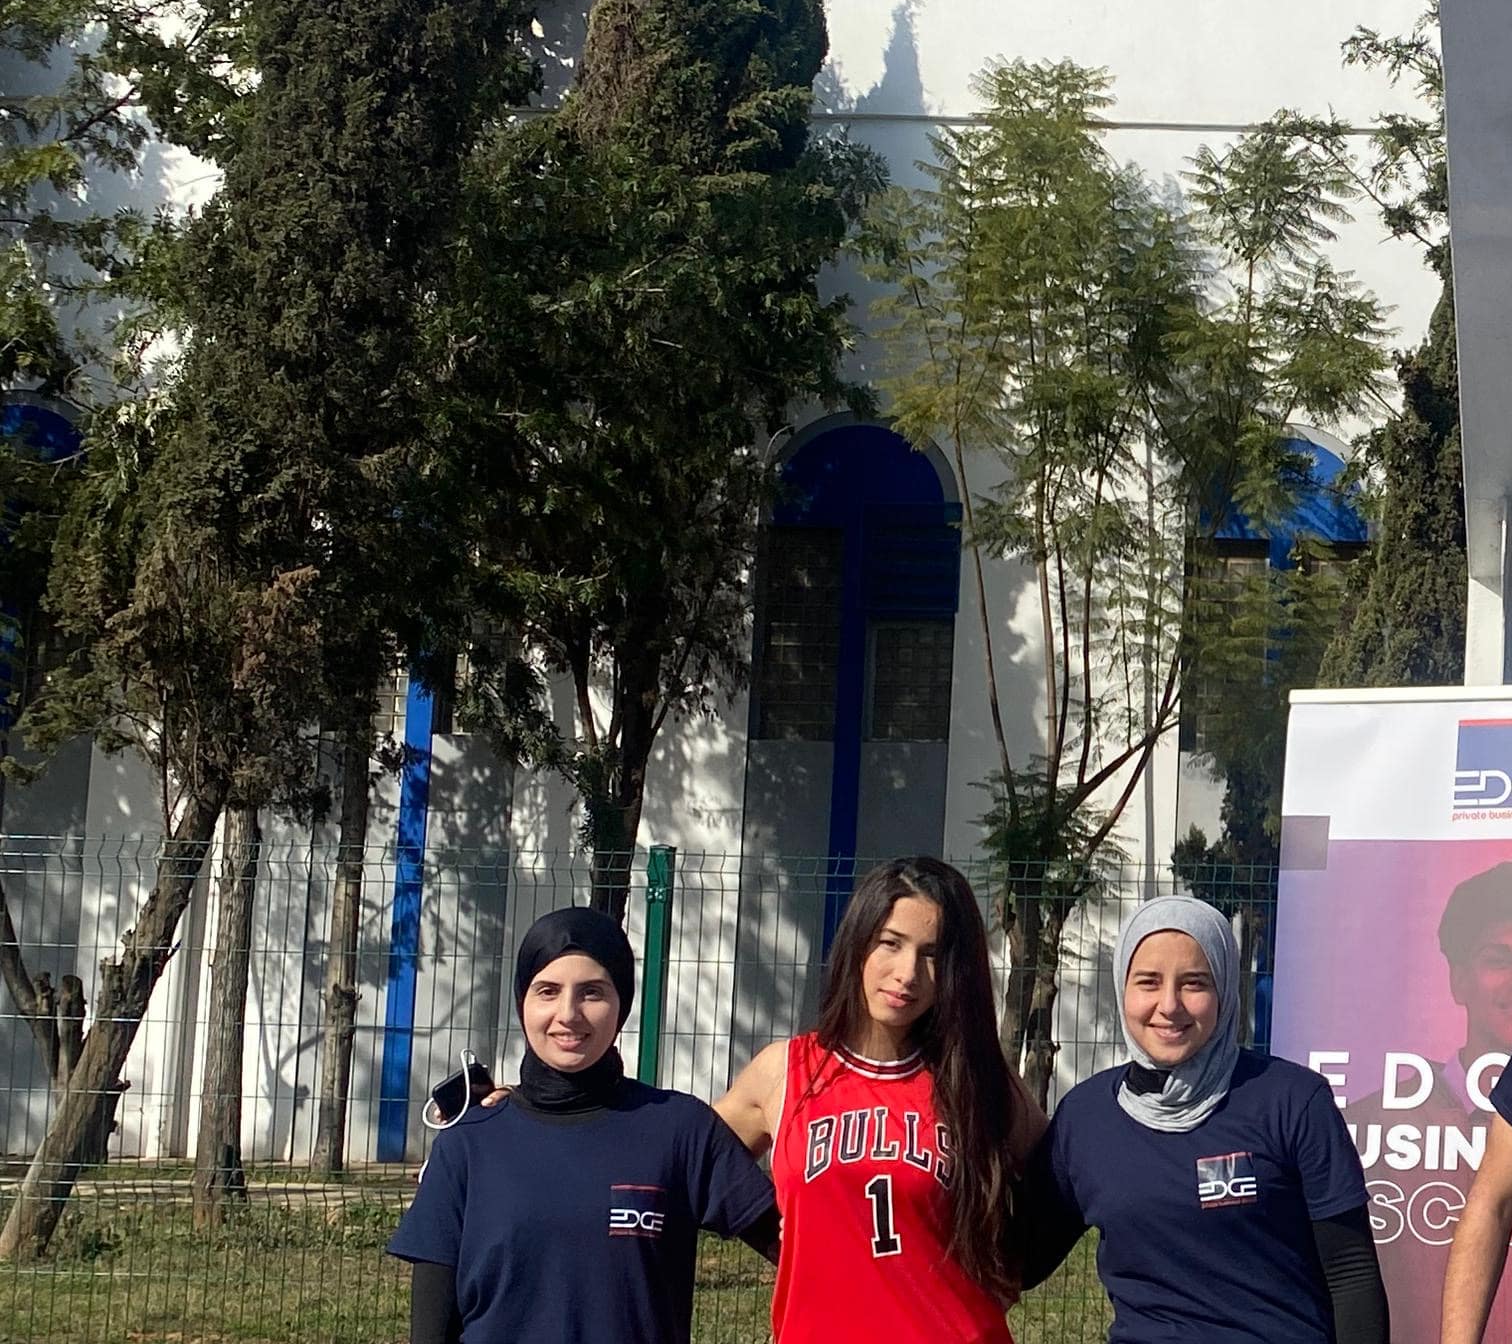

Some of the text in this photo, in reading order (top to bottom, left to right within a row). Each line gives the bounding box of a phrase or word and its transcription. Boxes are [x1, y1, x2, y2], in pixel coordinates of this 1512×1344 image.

[1452, 811, 1487, 822] private
[805, 1107, 957, 1190] BULLS
[1199, 1177, 1257, 1202] EDGE
[609, 1209, 665, 1232] EDGE
[865, 1174, 902, 1258] 1
